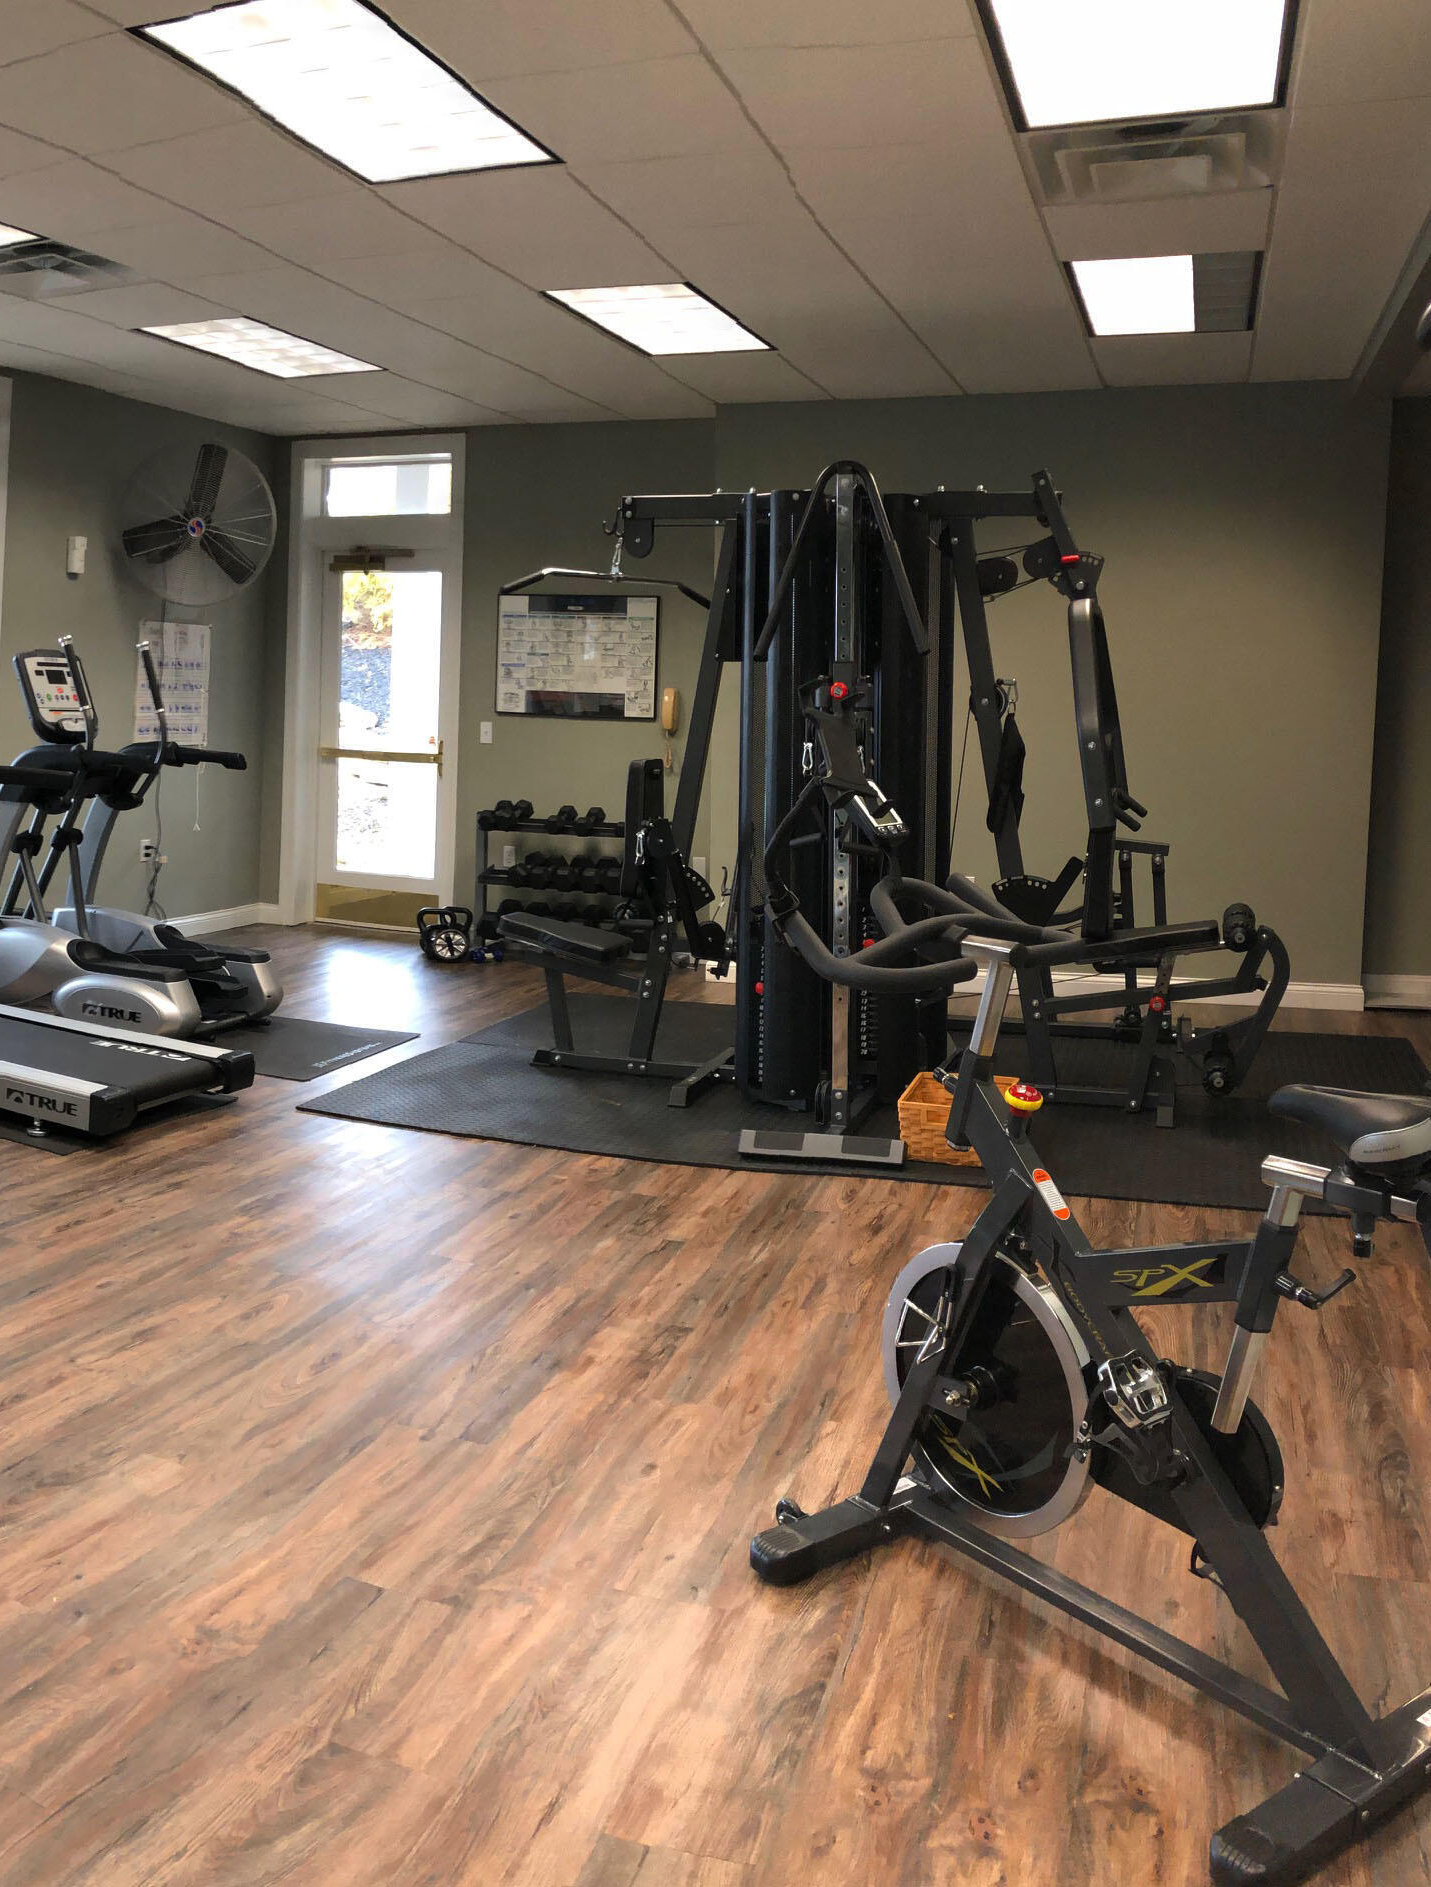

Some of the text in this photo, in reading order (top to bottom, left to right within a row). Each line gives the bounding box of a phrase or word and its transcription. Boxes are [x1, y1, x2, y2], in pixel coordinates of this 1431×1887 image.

[98, 1004, 142, 1024] TRUE
[24, 1093, 79, 1117] TRUE
[1108, 1257, 1218, 1297] SPX
[1063, 1281, 1113, 1358] BODYCRAF
